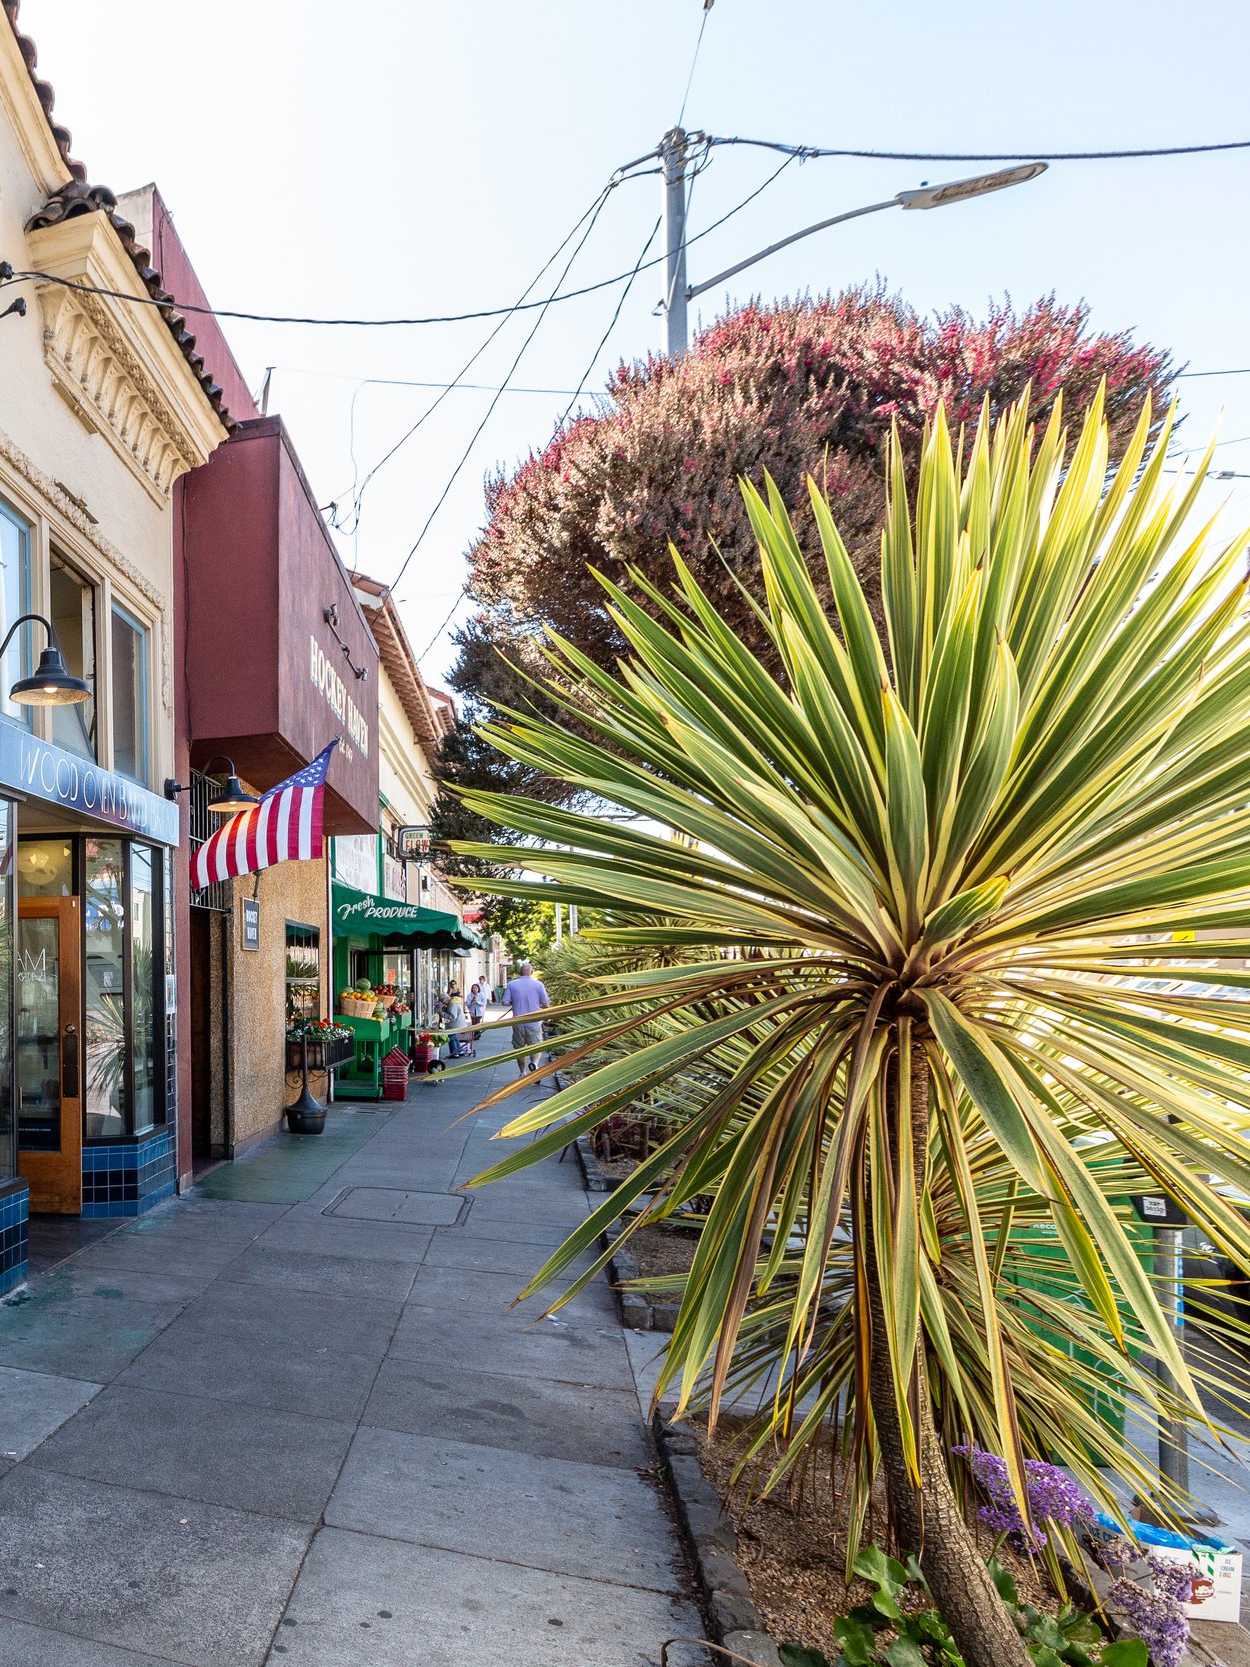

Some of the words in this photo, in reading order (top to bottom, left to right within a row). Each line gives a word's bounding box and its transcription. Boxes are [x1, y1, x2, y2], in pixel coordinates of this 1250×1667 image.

[310, 634, 347, 727] HOCKEY
[348, 695, 369, 759] HAVEN
[20, 740, 79, 802] WOOD
[83, 770, 116, 815] OVEN
[337, 895, 376, 921] Fresh
[364, 906, 419, 919] PRODUCE
